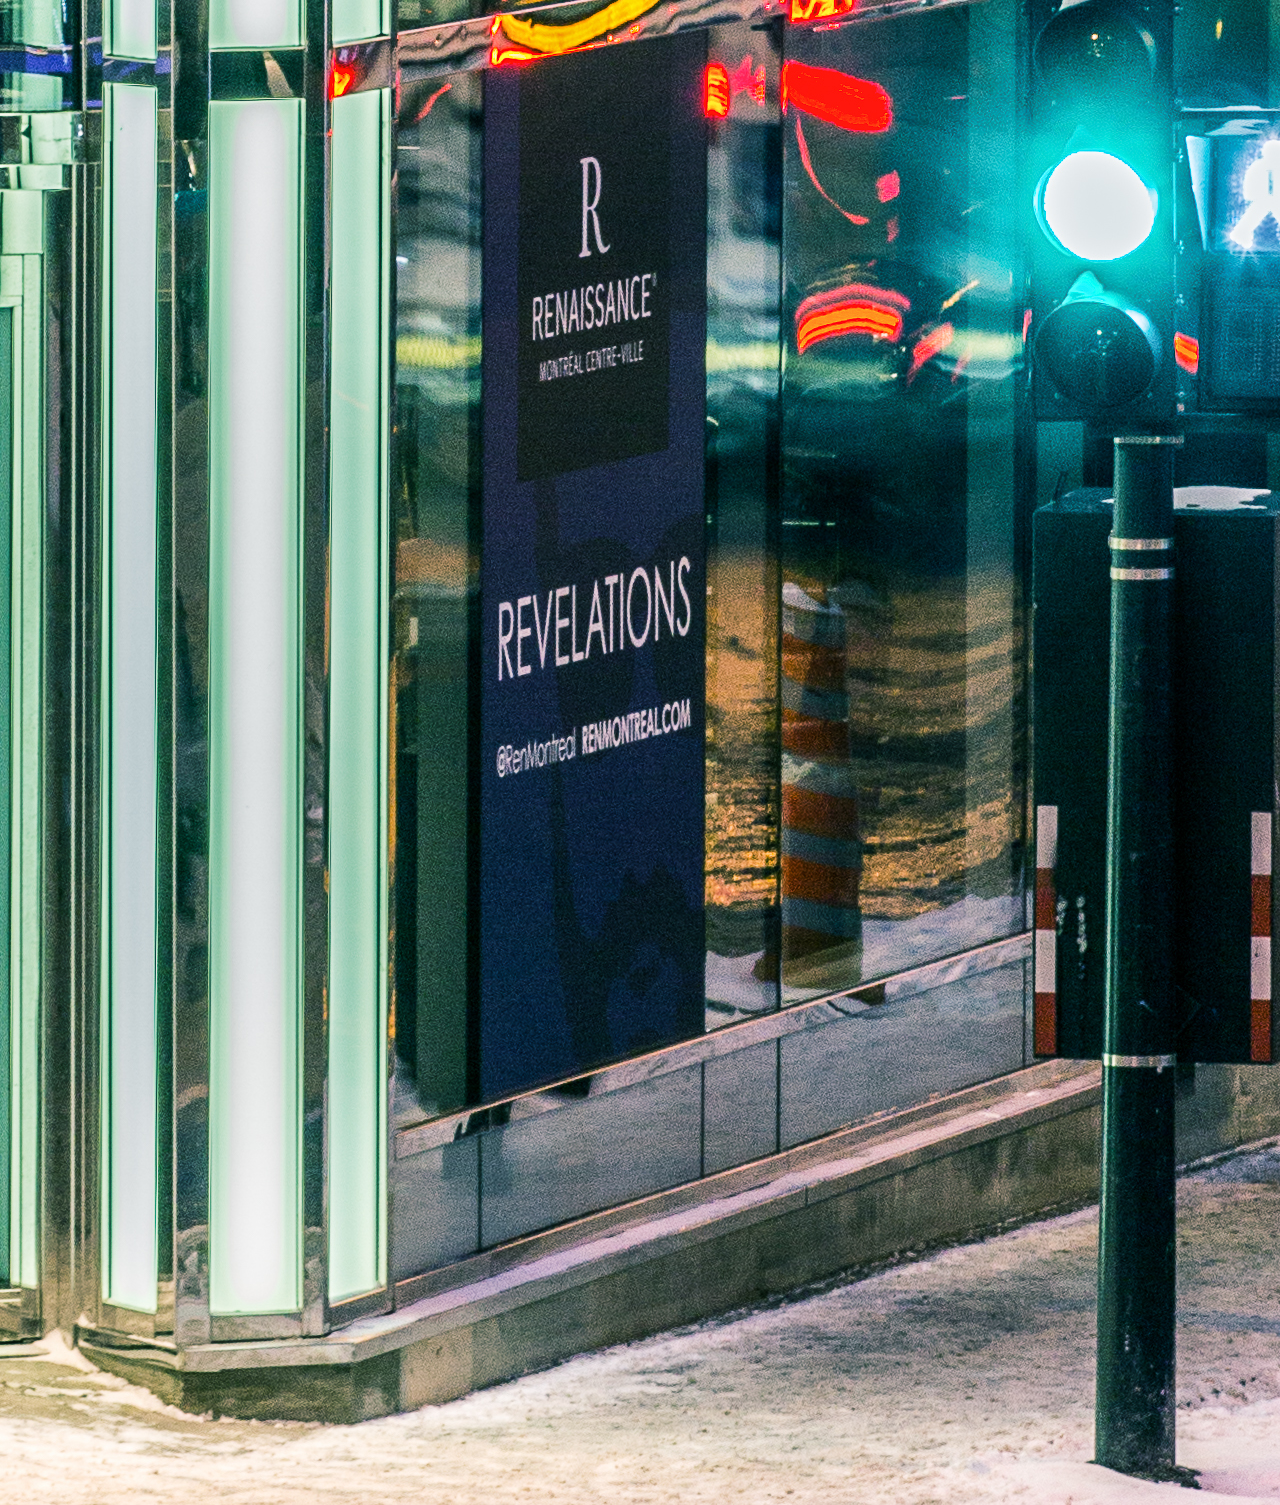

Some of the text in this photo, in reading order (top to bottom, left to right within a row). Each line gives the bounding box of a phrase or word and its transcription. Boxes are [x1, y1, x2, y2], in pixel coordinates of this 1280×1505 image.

[578, 156, 611, 258] R
[532, 273, 652, 341] RENAISSANCE
[539, 340, 644, 382] MONTRÉAL CENTRE-VILLE
[497, 555, 691, 682] REVELATIONS
[496, 698, 691, 778] @RenMontreal RENMONTREAL.COM
